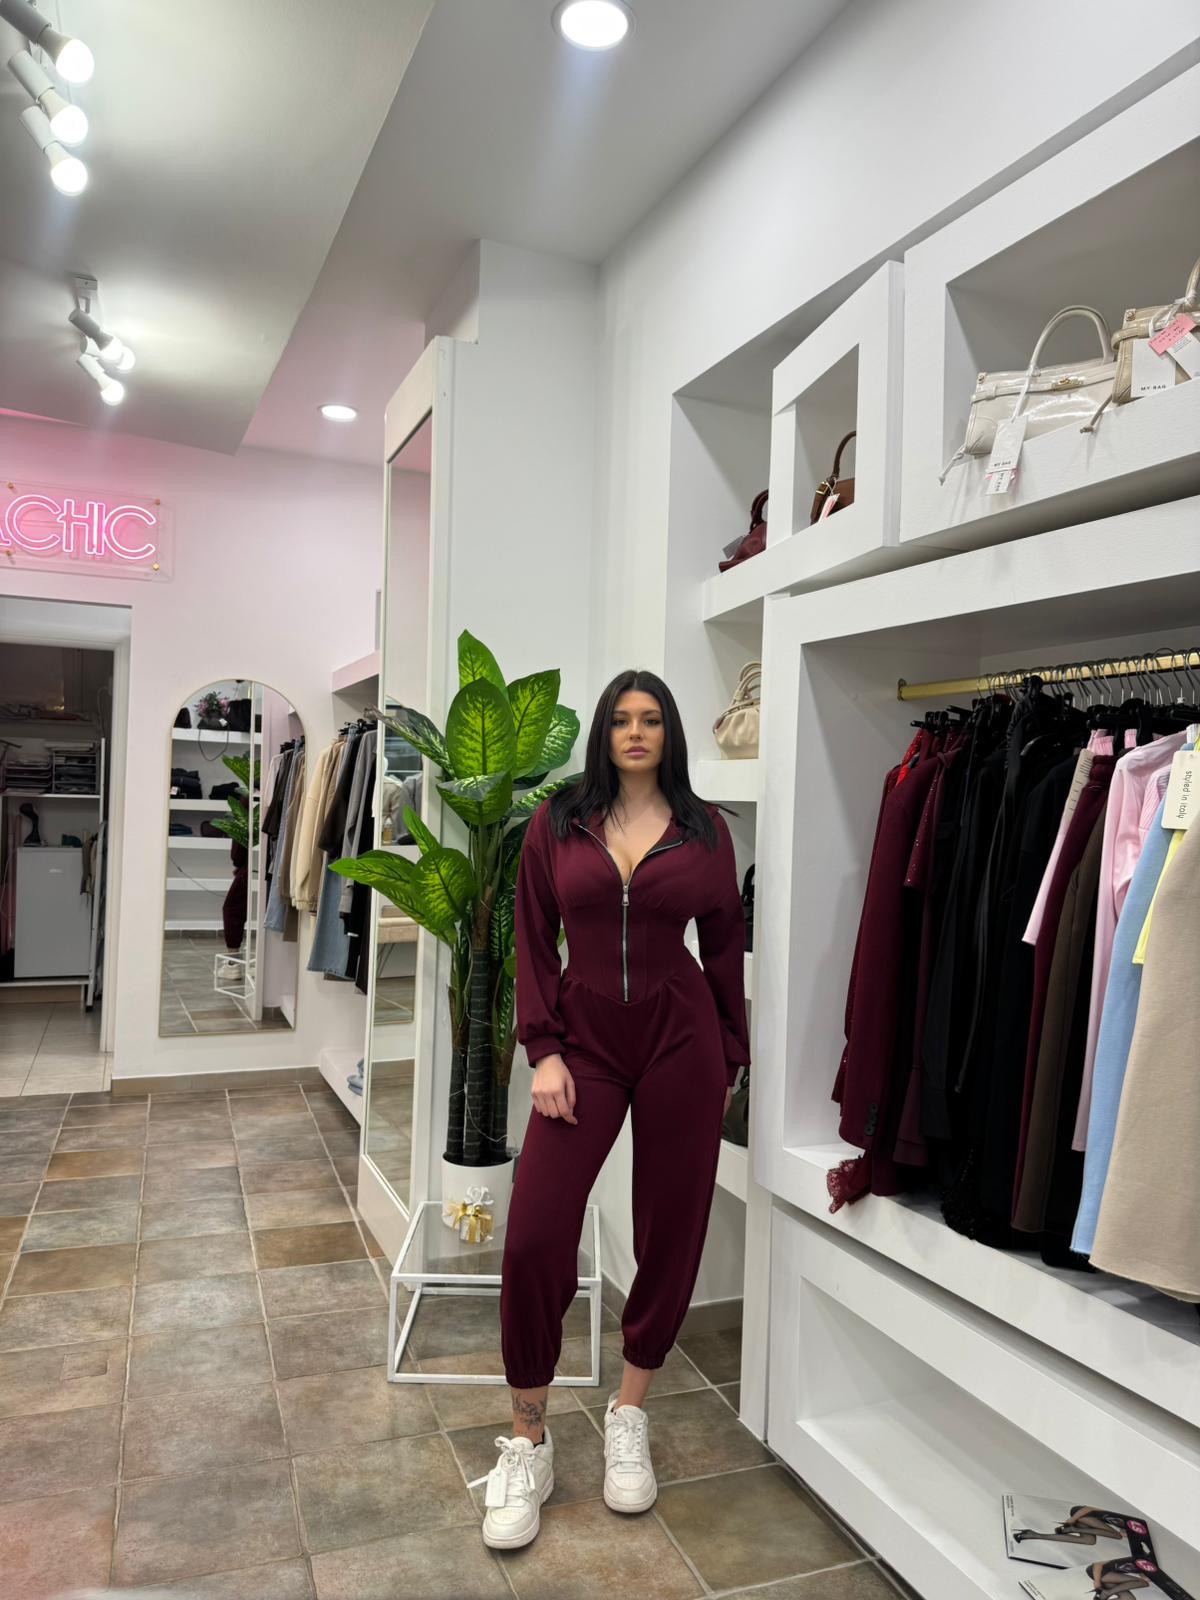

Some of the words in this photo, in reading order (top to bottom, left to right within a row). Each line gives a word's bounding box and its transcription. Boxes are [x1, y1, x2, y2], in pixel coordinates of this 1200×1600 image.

[0, 494, 157, 560] CHIC
[1182, 770, 1192, 793] styled
[1175, 802, 1188, 819] italy
